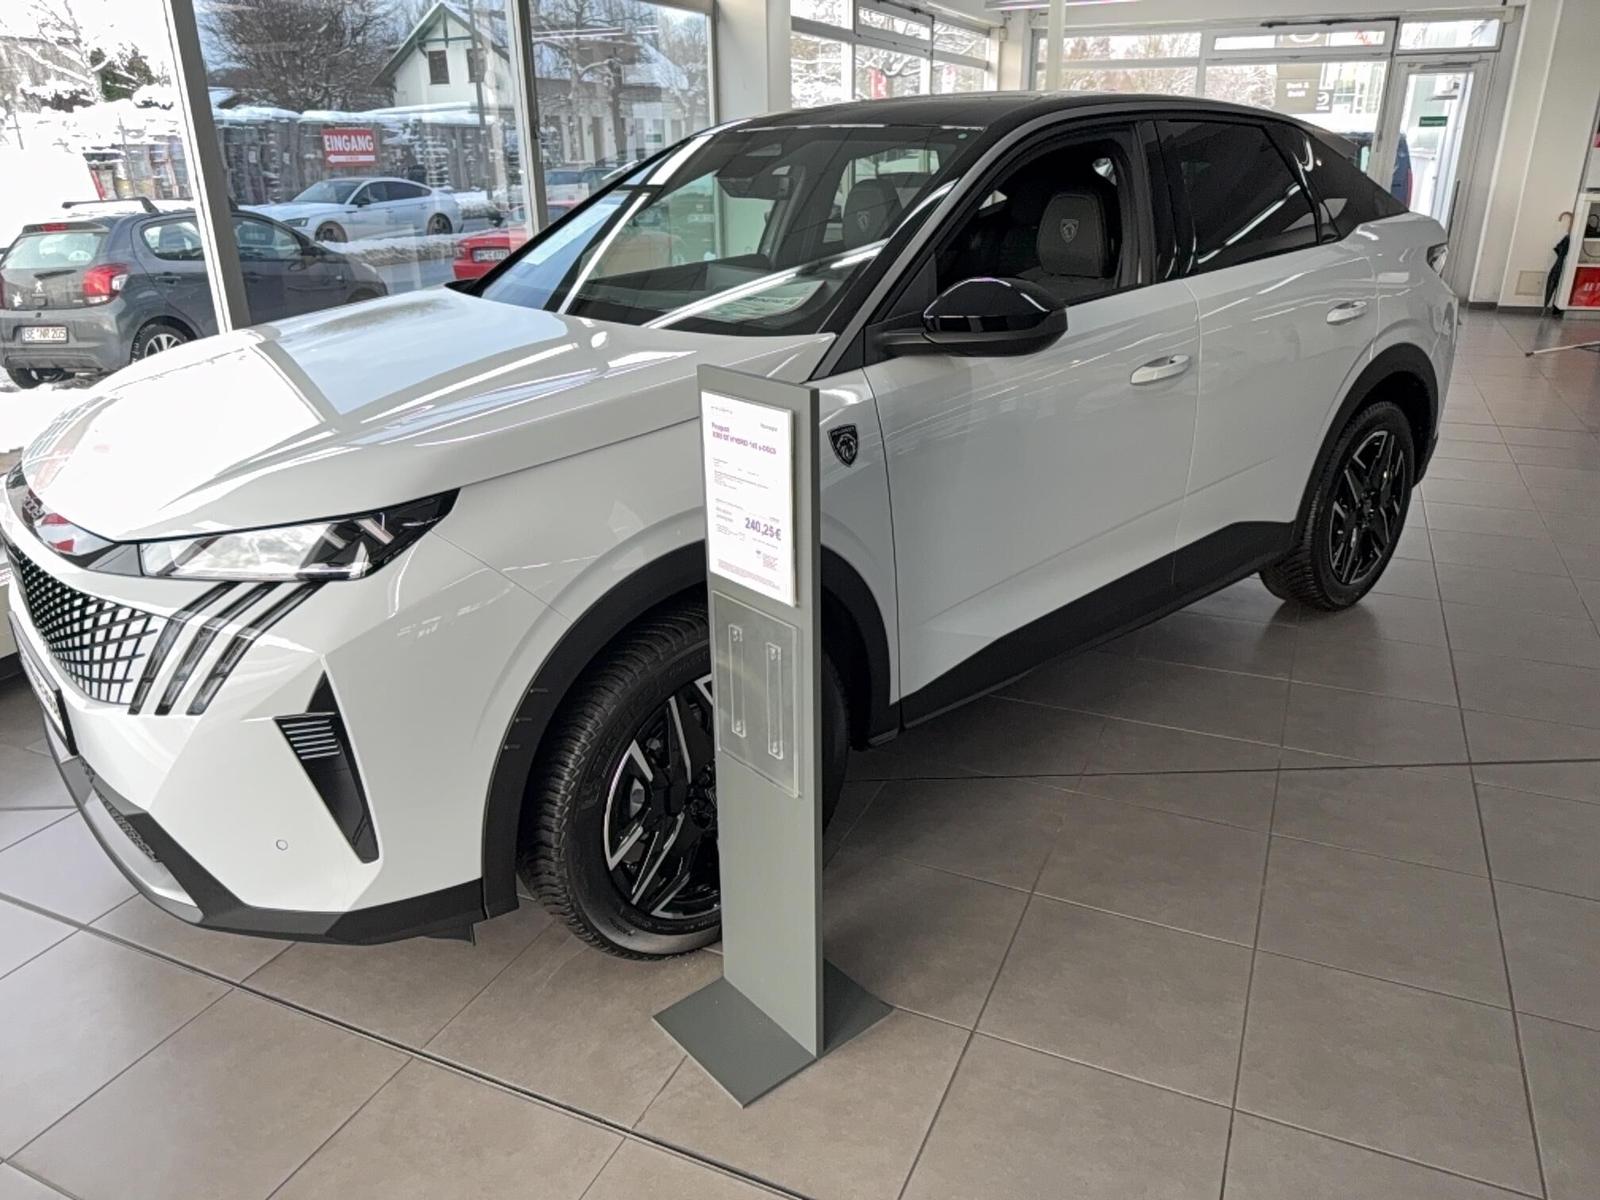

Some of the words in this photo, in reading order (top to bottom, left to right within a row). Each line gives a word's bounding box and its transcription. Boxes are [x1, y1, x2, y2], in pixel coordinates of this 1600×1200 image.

[323, 135, 374, 151] EINGANG
[25, 328, 36, 339] SE
[39, 328, 49, 339] NR
[51, 328, 66, 339] 205
[745, 517, 782, 541] 240,25€
